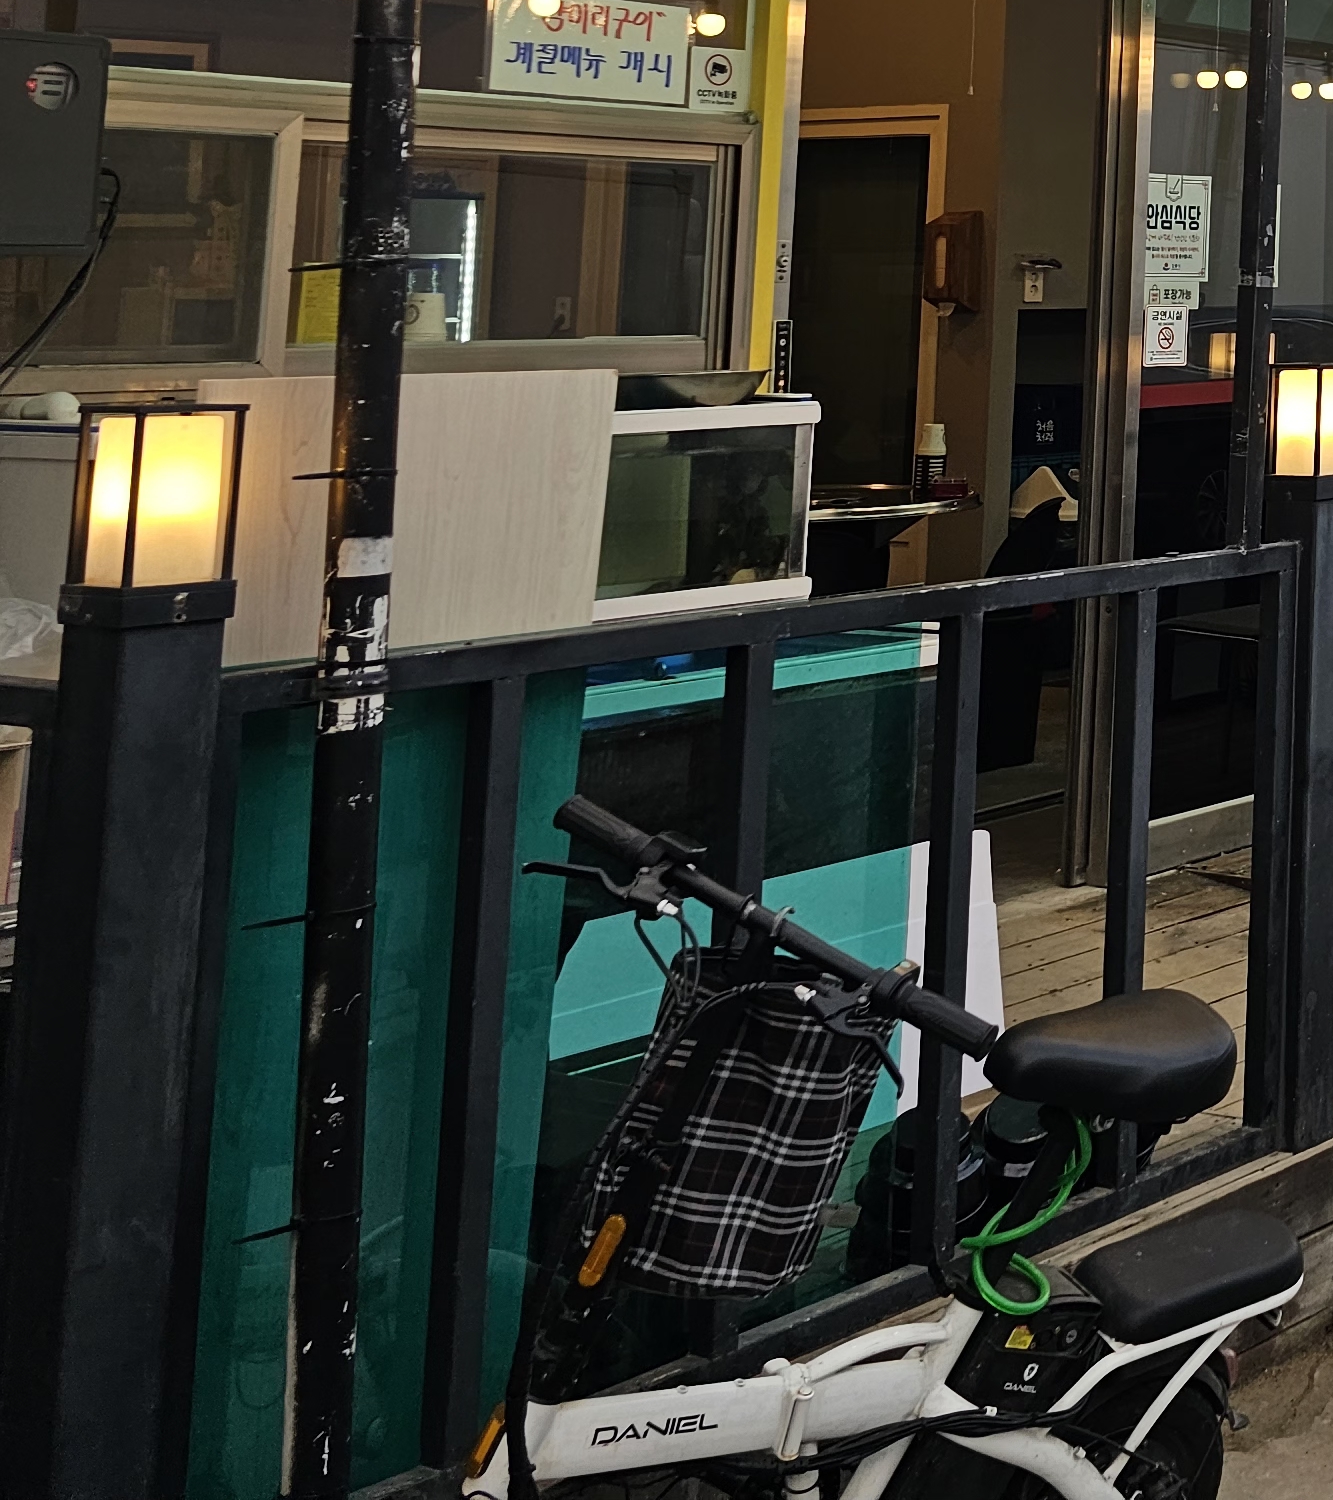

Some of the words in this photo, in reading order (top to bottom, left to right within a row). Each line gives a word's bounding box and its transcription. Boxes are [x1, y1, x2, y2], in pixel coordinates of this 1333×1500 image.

[505, 40, 607, 80] 계절메뉴
[618, 50, 673, 88] 개시
[1147, 203, 1201, 231] 안심식당
[1163, 288, 1192, 300] 포장가능
[589, 1412, 719, 1448] DANIEL
